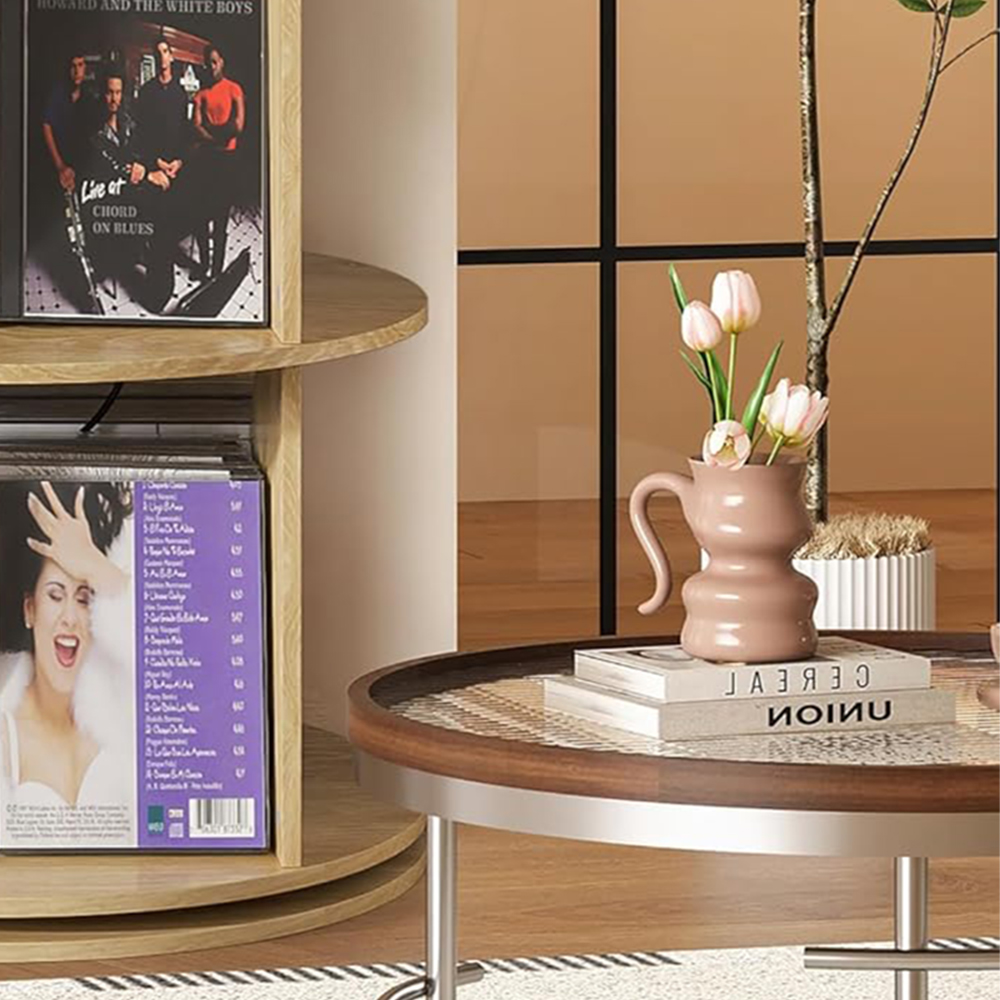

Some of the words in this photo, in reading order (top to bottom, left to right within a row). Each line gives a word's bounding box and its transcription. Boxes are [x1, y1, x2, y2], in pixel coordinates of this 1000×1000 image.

[165, 0, 213, 14] WHITE
[216, 0, 253, 15] BOYS
[93, 204, 137, 218] CHORD
[93, 222, 112, 235] ON
[114, 222, 154, 236] BLUES
